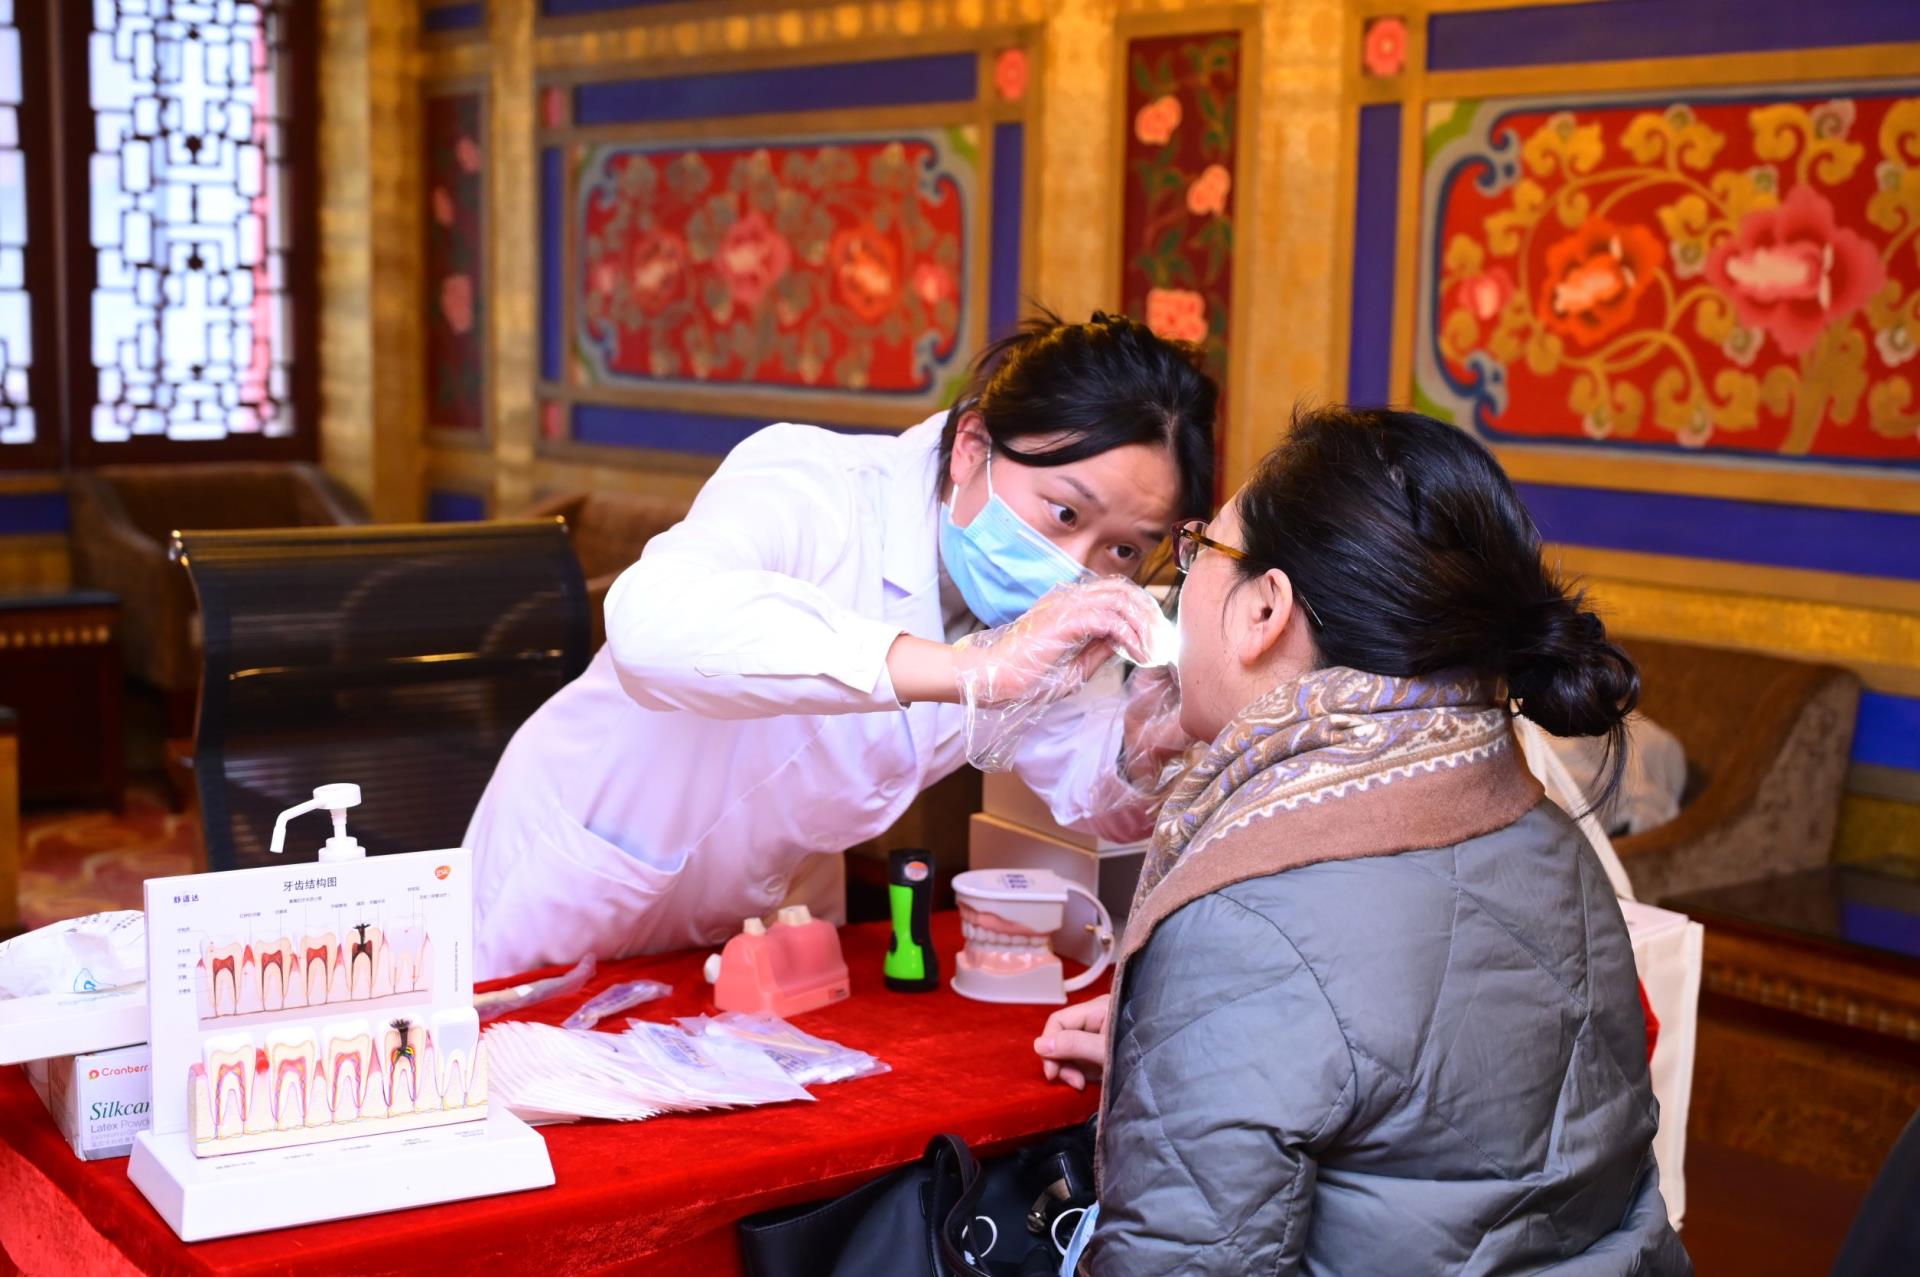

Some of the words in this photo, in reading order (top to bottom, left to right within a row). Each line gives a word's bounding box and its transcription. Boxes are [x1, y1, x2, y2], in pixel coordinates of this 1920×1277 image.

[283, 876, 337, 892] 牙齿结构图
[101, 1064, 150, 1077] Cranberr
[91, 1122, 118, 1134] Latex
